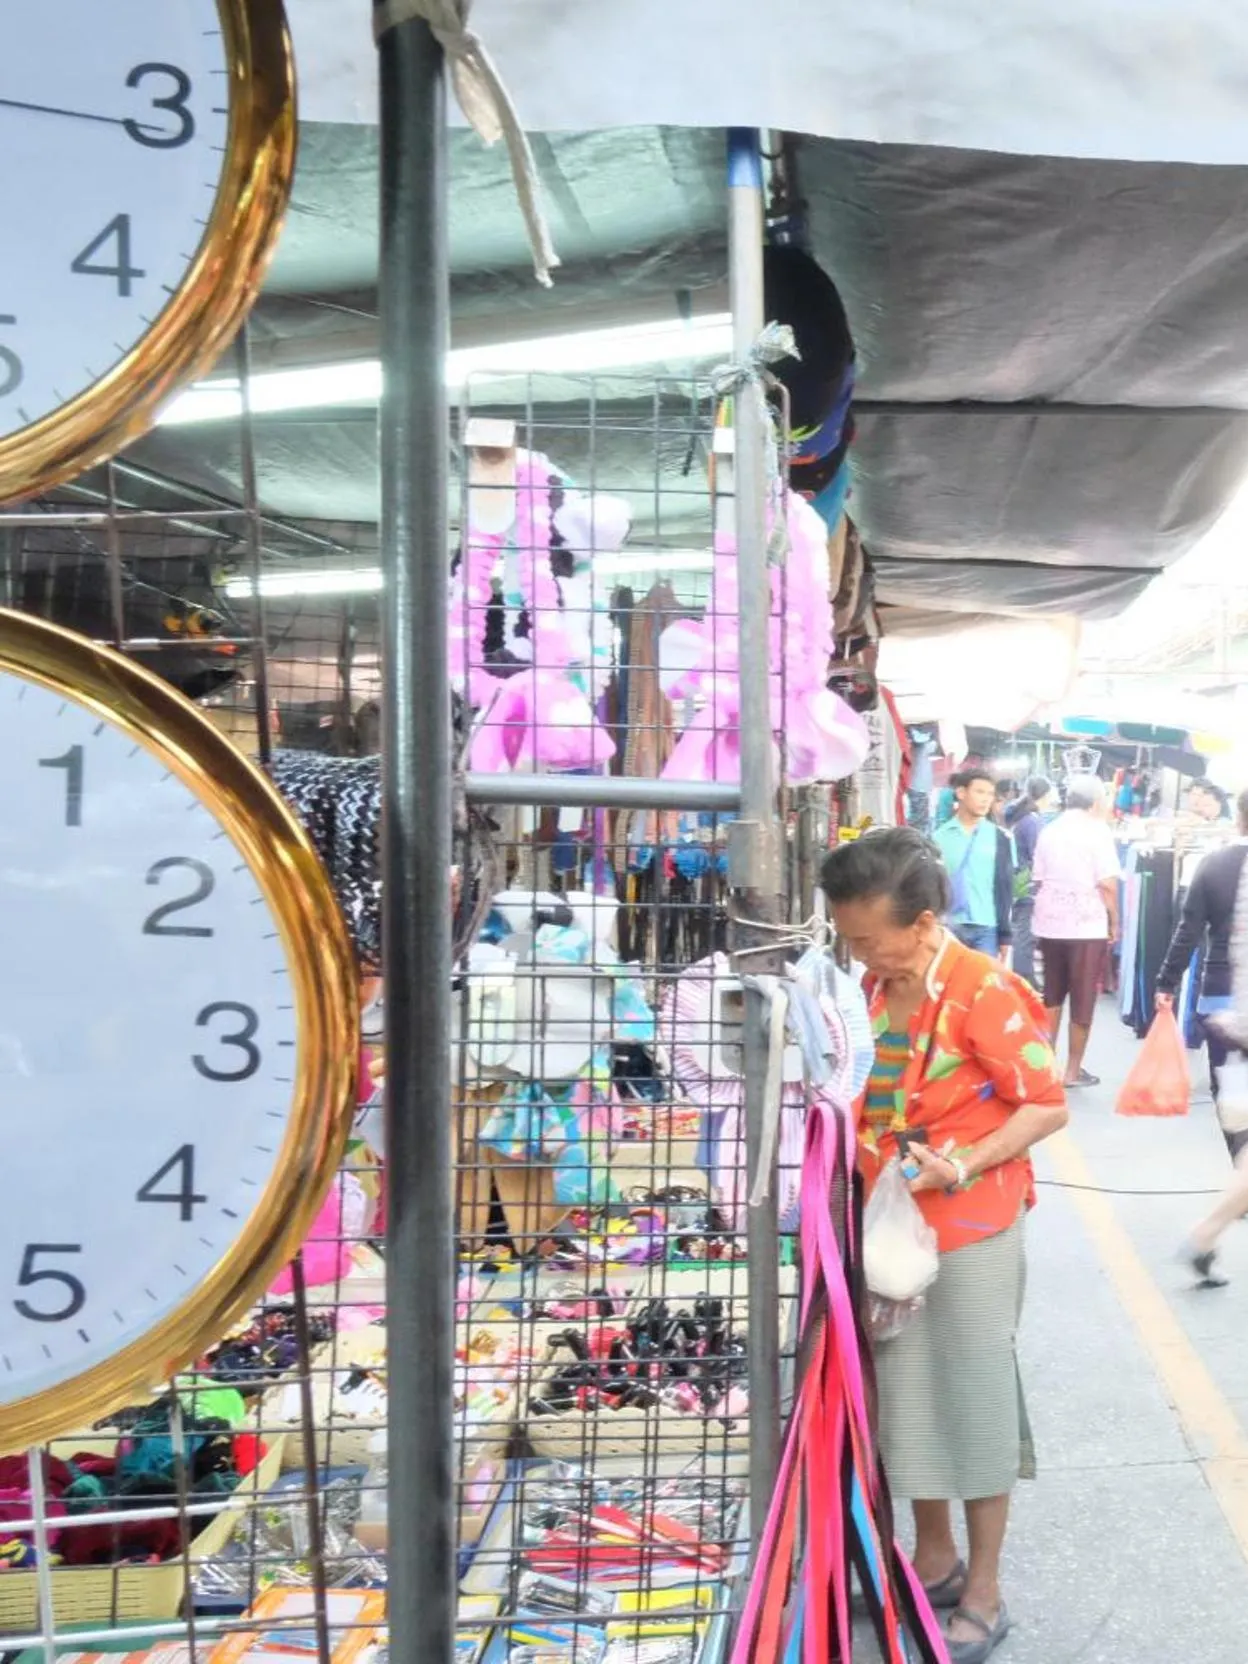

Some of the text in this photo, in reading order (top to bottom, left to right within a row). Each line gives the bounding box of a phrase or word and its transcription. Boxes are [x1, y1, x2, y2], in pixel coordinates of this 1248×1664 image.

[122, 62, 196, 149] 3
[70, 213, 146, 298] 4
[39, 745, 83, 827] 1
[142, 856, 214, 938] 2
[193, 1001, 261, 1083] 3
[136, 1144, 207, 1222] 4
[13, 1243, 87, 1323] 5
